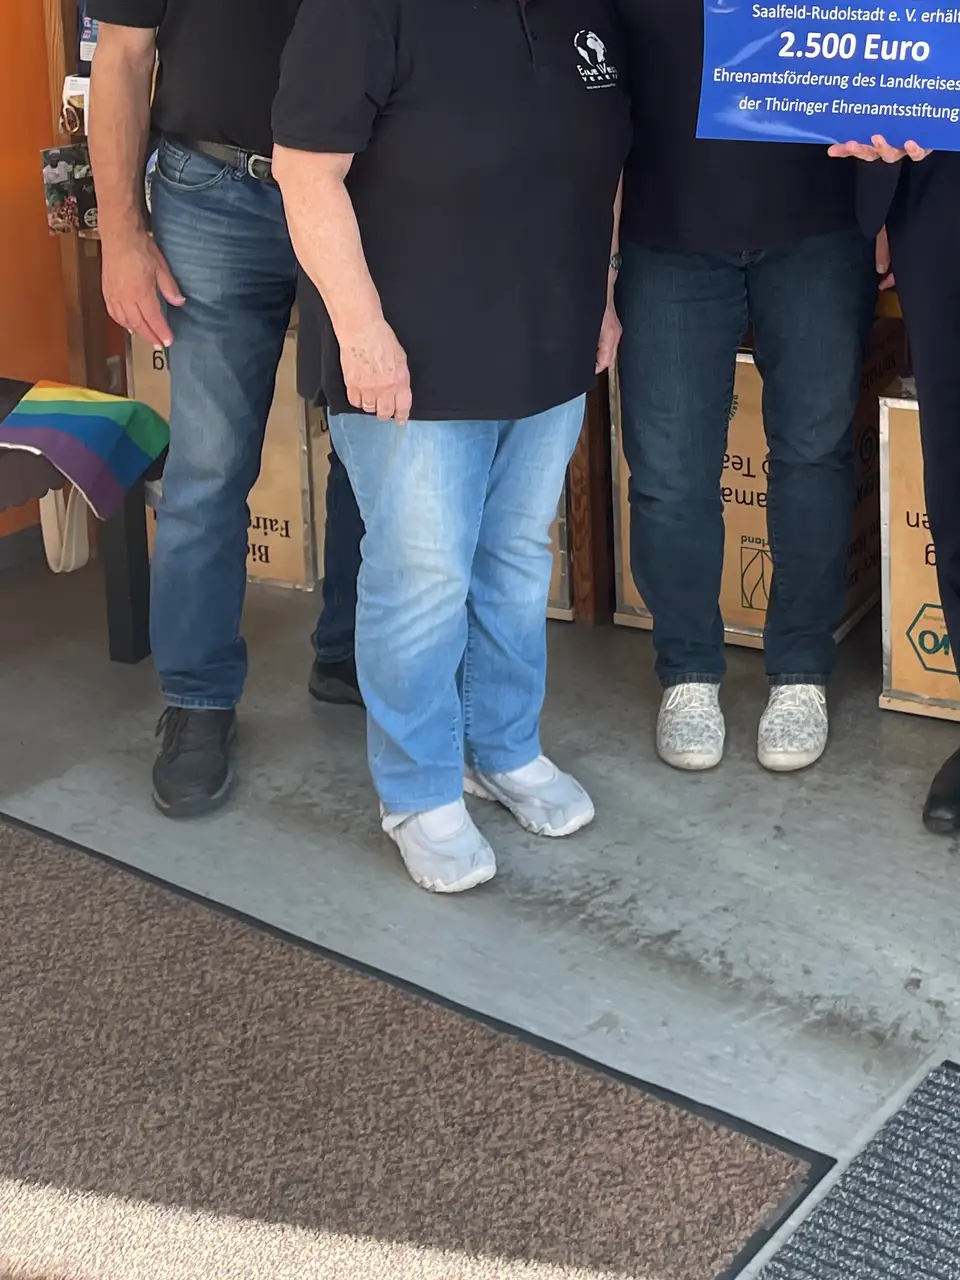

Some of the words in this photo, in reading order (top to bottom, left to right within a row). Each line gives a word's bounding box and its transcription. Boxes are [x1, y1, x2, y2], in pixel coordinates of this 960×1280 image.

[752, 4, 885, 22] Saalfeld-Rudolstadt
[888, 11, 900, 22] e.
[905, 9, 918, 23] V.
[778, 31, 856, 59] 2.500
[864, 33, 930, 62] Euro
[713, 68, 849, 90] Ehrenamtsförderung
[852, 72, 876, 87] des
[739, 96, 761, 111] der
[765, 97, 828, 115] Thüringer
[831, 100, 960, 122] Ehrenamtsstiftung
